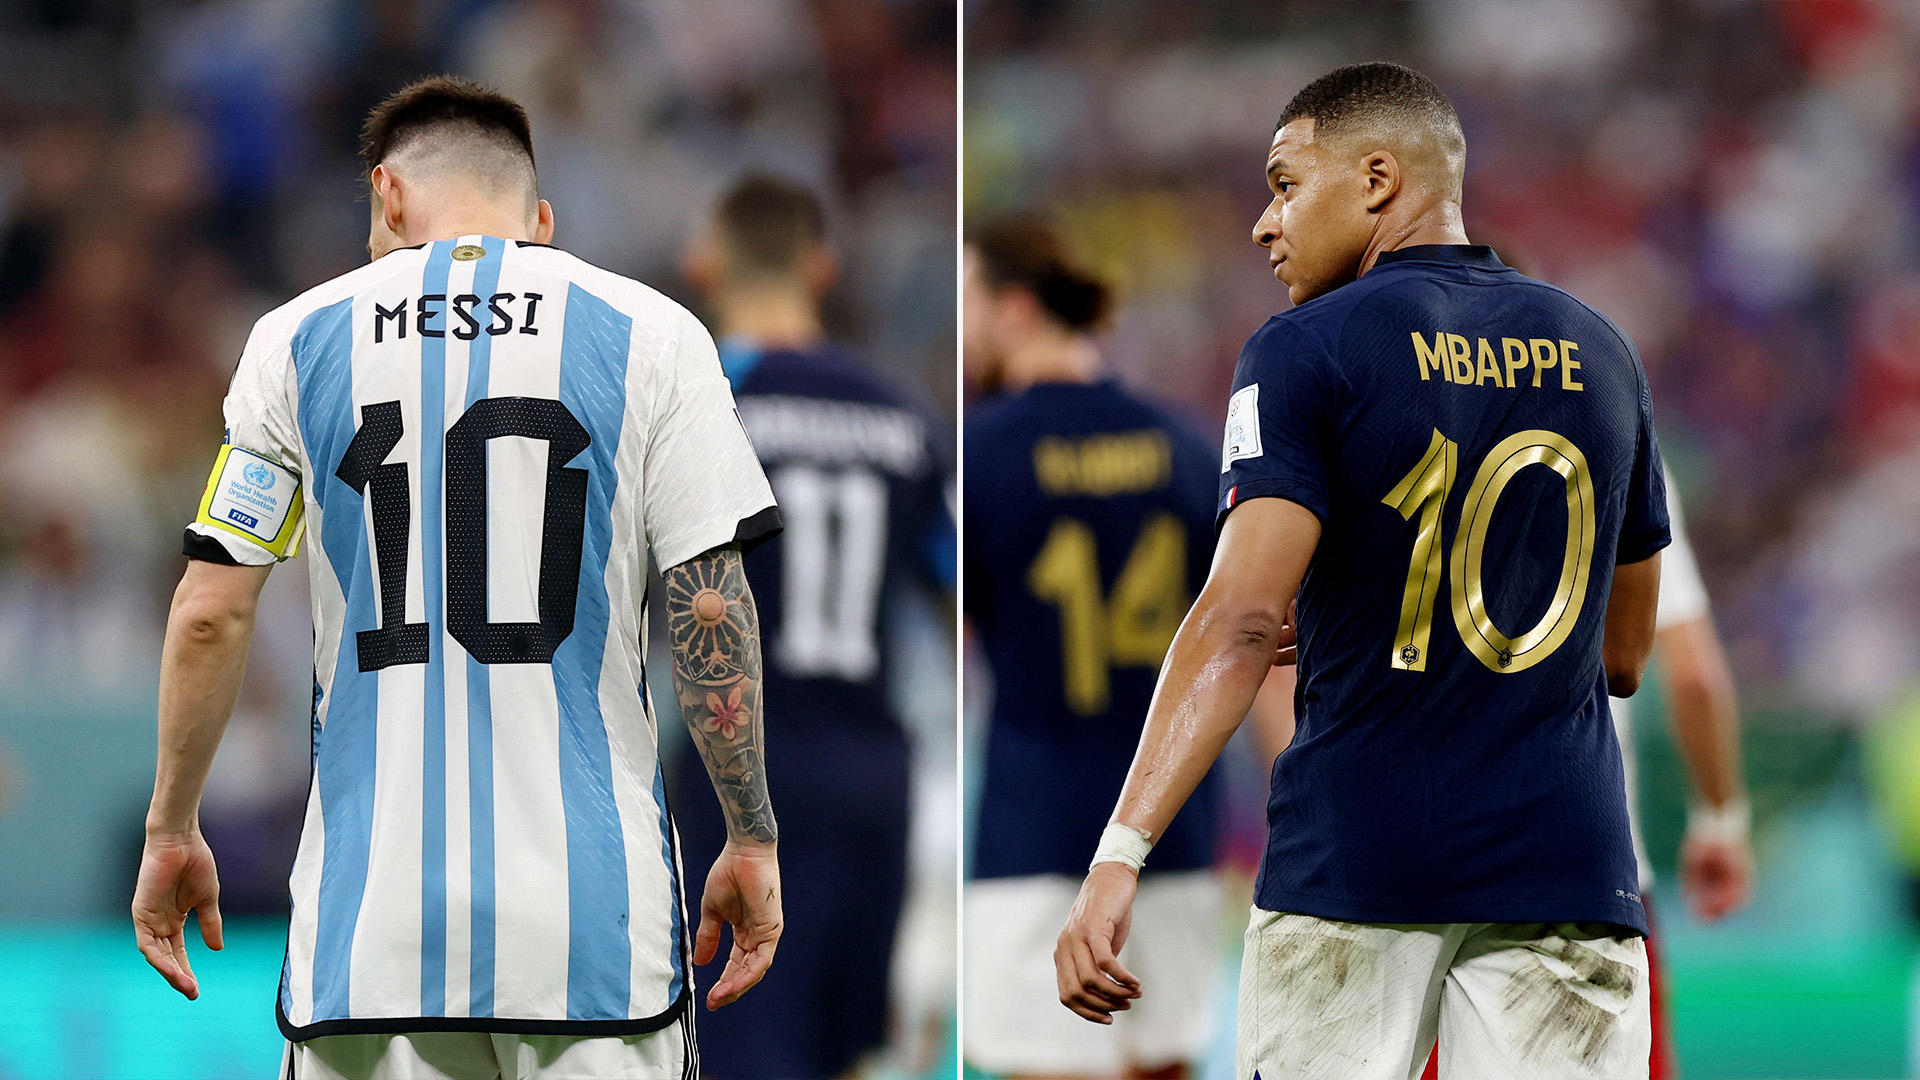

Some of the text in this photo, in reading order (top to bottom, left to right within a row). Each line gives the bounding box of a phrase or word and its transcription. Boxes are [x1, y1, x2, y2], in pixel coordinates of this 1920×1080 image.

[375, 292, 543, 343] MESSI
[1410, 331, 1584, 391] MBAPPE
[228, 488, 275, 513] Organization
[231, 480, 277, 506] World Health
[231, 511, 252, 525] FIFA
[335, 396, 591, 672] 10
[1381, 427, 1595, 674] 10
[779, 468, 887, 680] 11
[1029, 513, 1187, 715] 14
